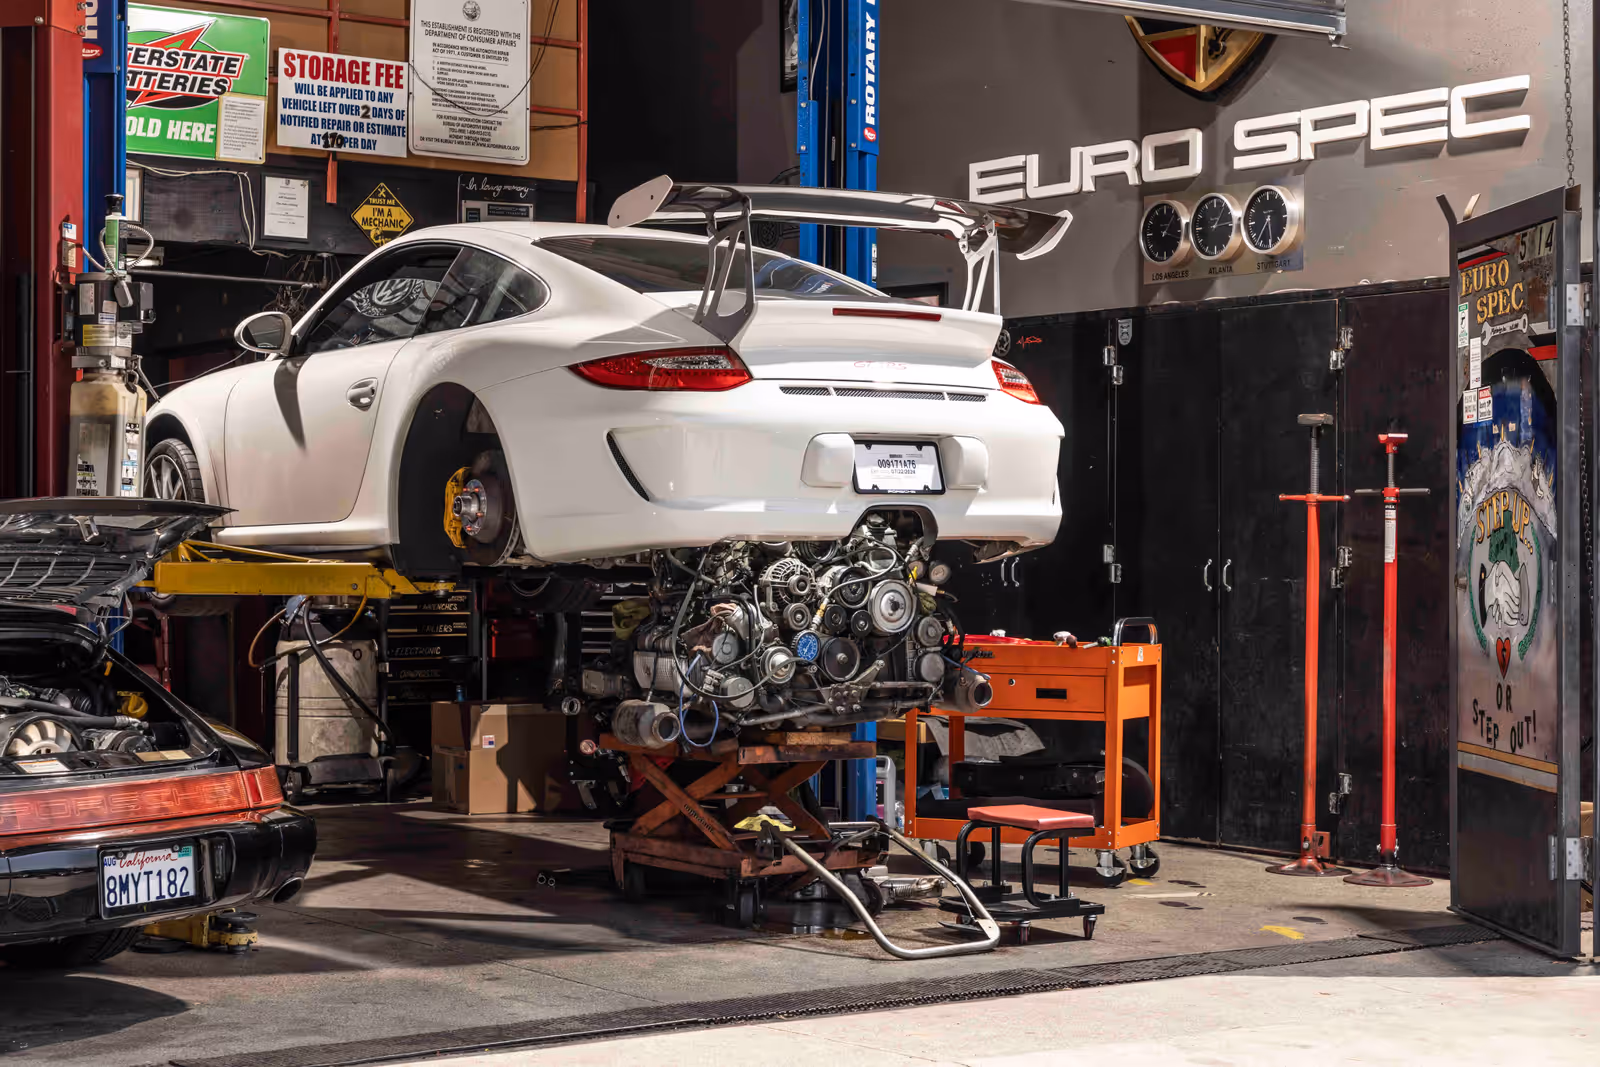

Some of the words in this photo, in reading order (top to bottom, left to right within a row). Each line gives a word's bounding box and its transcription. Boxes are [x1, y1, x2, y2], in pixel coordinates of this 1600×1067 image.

[421, 20, 431, 28] THIS
[431, 21, 467, 33] ESTABLISHMENT
[468, 26, 473, 34] IS
[473, 27, 499, 37] REGISTERED
[500, 31, 512, 39] WITH
[512, 32, 521, 40] THE
[425, 29, 458, 40] DEPARTMENT
[458, 33, 466, 41] OF
[466, 34, 496, 45] CONSUMER
[496, 38, 517, 47] AFFAIRS
[283, 52, 371, 86] STORAGE
[375, 62, 404, 90] FEE
[865, 11, 876, 125] ROTARY
[126, 69, 229, 96] TTERIES
[294, 82, 315, 96] WILL
[317, 85, 328, 97] BE
[329, 86, 363, 101] APPLIED
[365, 89, 376, 102] TO
[377, 91, 394, 104] ANY
[281, 97, 317, 112] VEHICLE
[319, 101, 337, 114] LEFT
[338, 103, 360, 117] OVER
[360, 104, 372, 119] 2
[372, 106, 394, 120] DAYS
[395, 108, 406, 121] OF
[166, 119, 217, 143] HERE
[280, 113, 319, 129] NOTIFIED
[321, 117, 351, 132] REPAIR
[353, 121, 365, 134] OR
[366, 122, 406, 138] ESTIMATE
[310, 133, 321, 145] AT
[343, 136, 359, 149] PER
[361, 138, 377, 151] DAY
[969, 128, 1203, 204] EURO
[1233, 74, 1531, 171] SPEC
[369, 197, 387, 205] TRUST
[372, 207, 385, 217] I'M
[386, 208, 393, 218] A
[361, 216, 405, 229] MECHANIC
[1152, 273, 1164, 281] LOS
[1164, 270, 1189, 280] ANGELES
[1208, 265, 1234, 275] ATLANTA
[1256, 260, 1291, 270] STUTTGART
[1460, 258, 1510, 298] EURO
[1476, 281, 1524, 325] SPEC
[877, 459, 917, 470] 009171A76
[1475, 490, 1510, 545] STEP
[1496, 682, 1514, 714] OR
[1472, 698, 1500, 749] STEP
[1510, 709, 1537, 754] OUT!
[104, 857, 117, 867] AUG
[119, 851, 178, 871] California
[106, 866, 190, 906] 8MYT182
